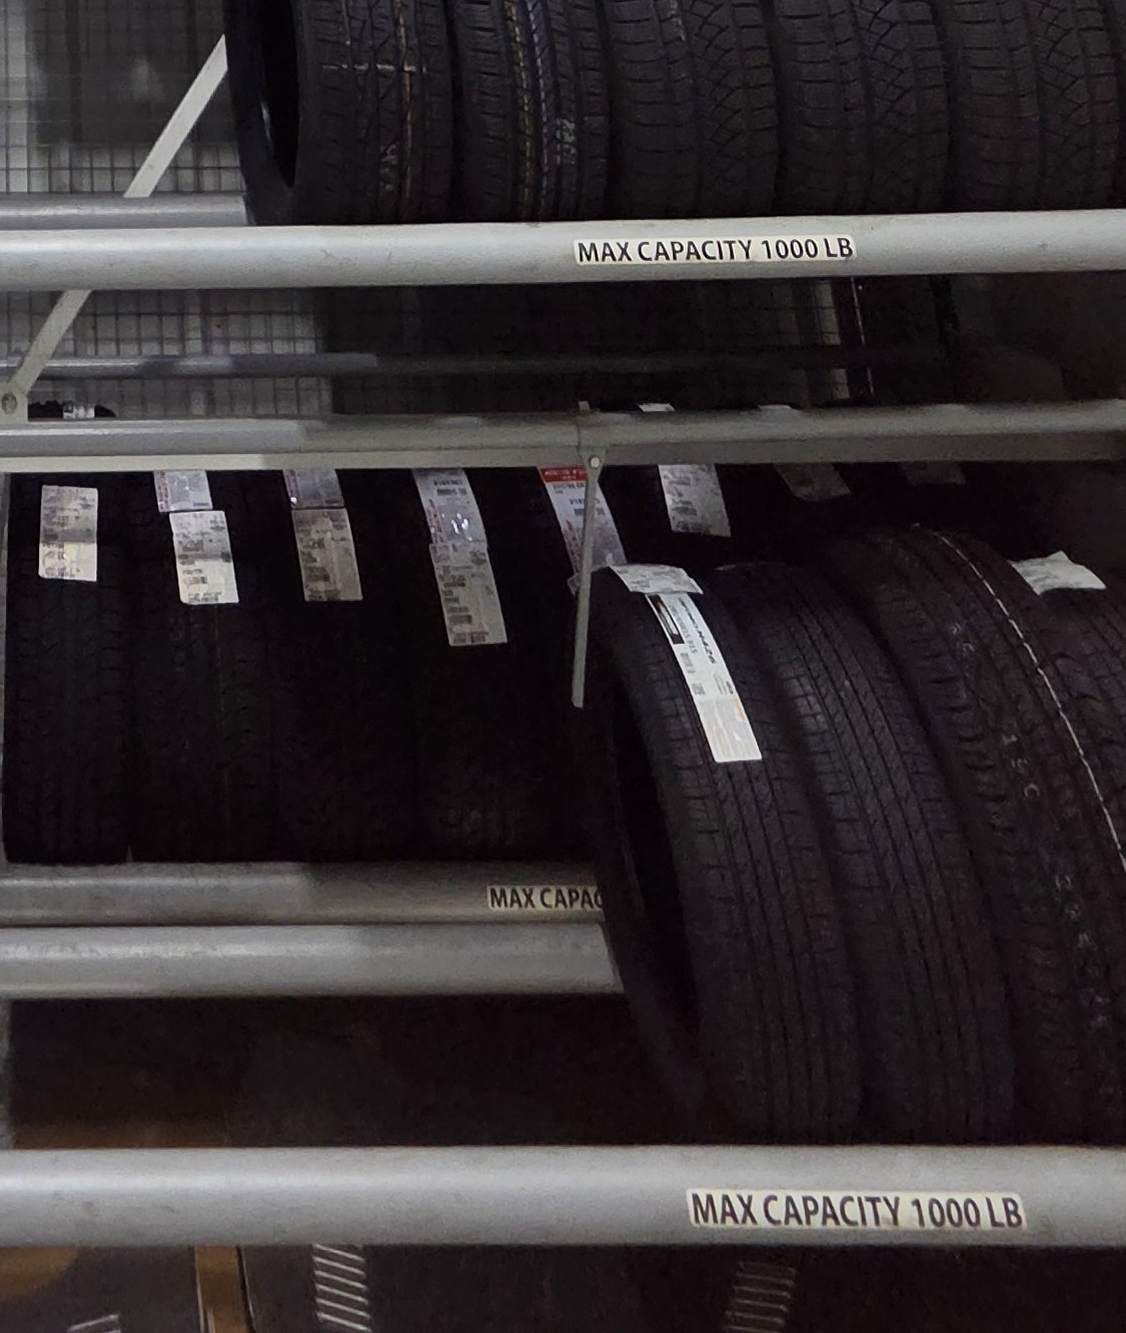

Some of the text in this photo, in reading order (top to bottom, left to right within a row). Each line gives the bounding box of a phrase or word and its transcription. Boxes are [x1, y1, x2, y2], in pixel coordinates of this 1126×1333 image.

[578, 237, 855, 263] MAX CAPACITY 1000 LB
[489, 886, 605, 910] MAX CAPAC
[690, 1191, 1024, 1230] MAX CAPACITY 1000 LB
